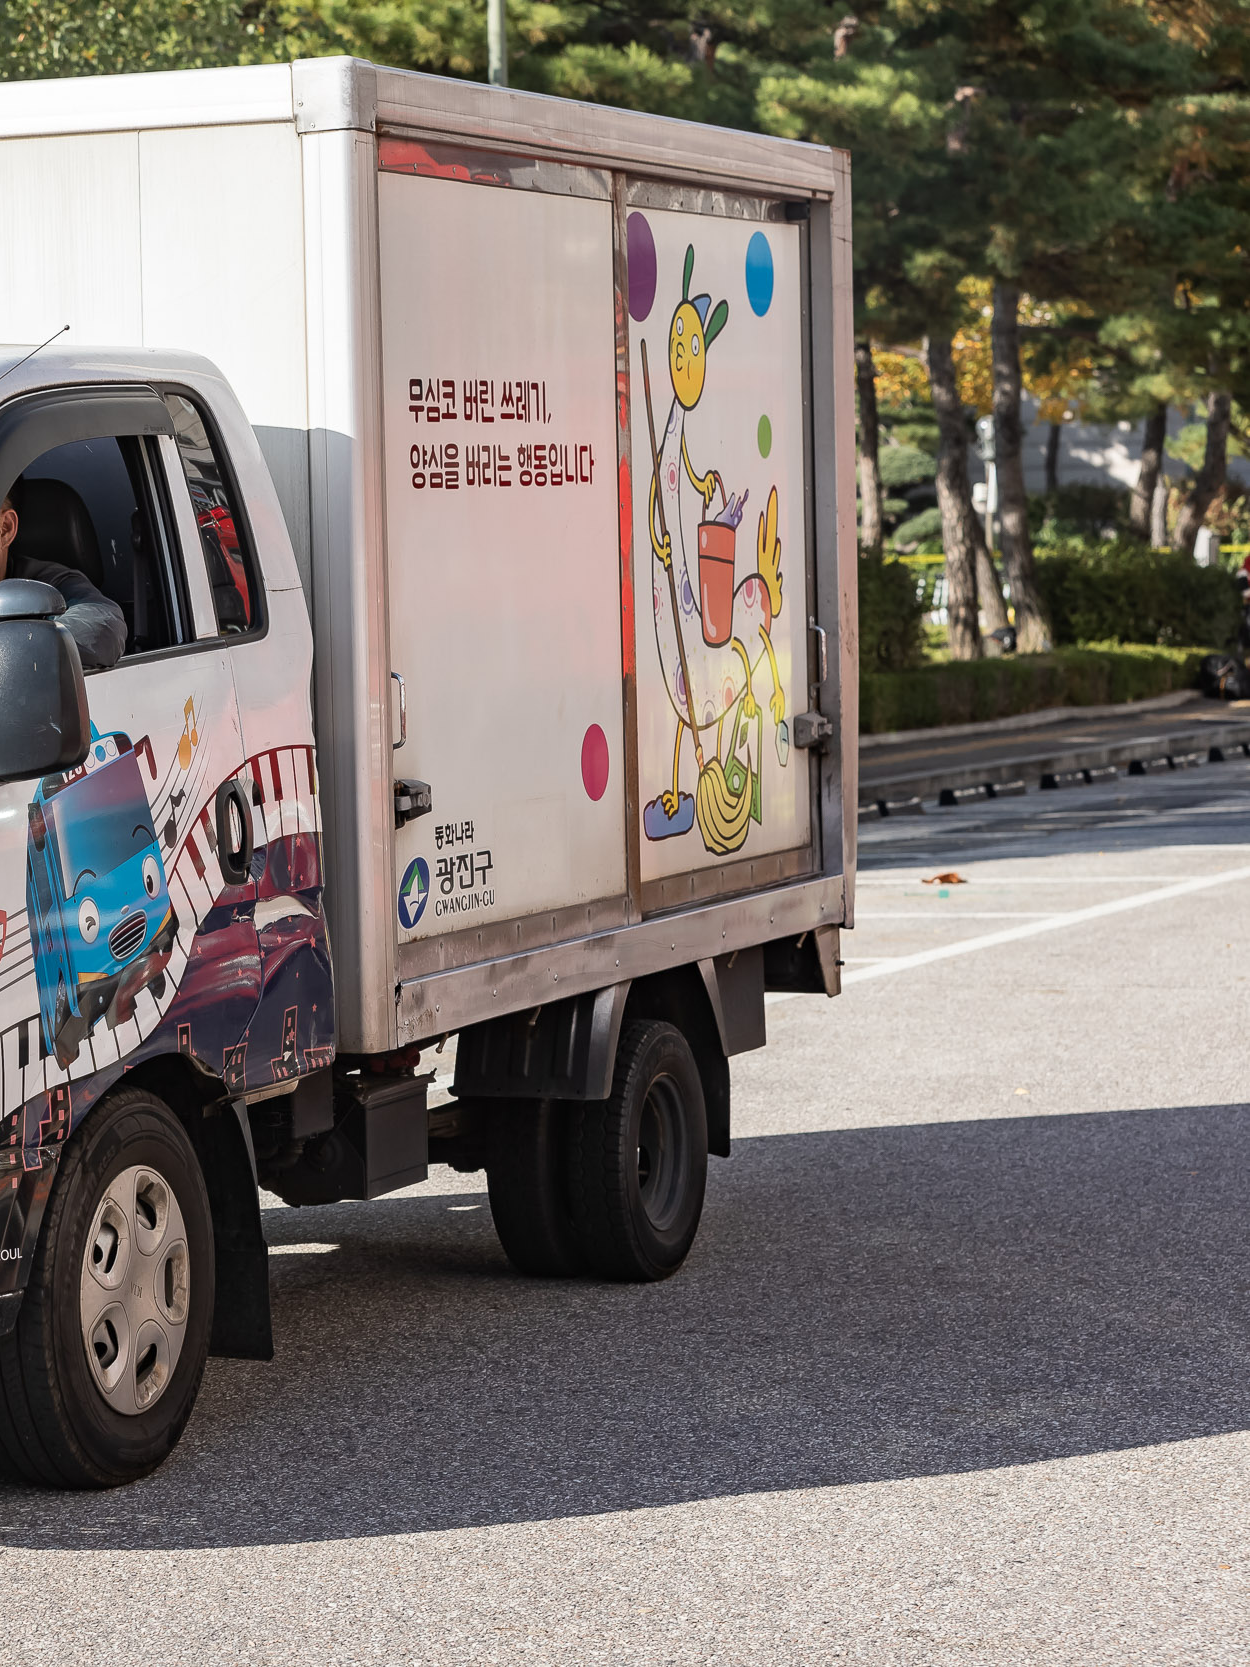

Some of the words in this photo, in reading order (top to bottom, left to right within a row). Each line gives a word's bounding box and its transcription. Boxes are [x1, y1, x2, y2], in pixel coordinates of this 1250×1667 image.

[408, 378, 458, 424] 무심코
[463, 379, 495, 423] 버린
[499, 380, 552, 424] 쓰레기,
[409, 443, 460, 490] 양심을
[466, 444, 512, 487] 버리는
[517, 443, 594, 487] 행동입니다
[435, 821, 474, 850] 동화나라
[435, 850, 494, 895] 광진구
[435, 889, 495, 917] GWANGJIN-GU
